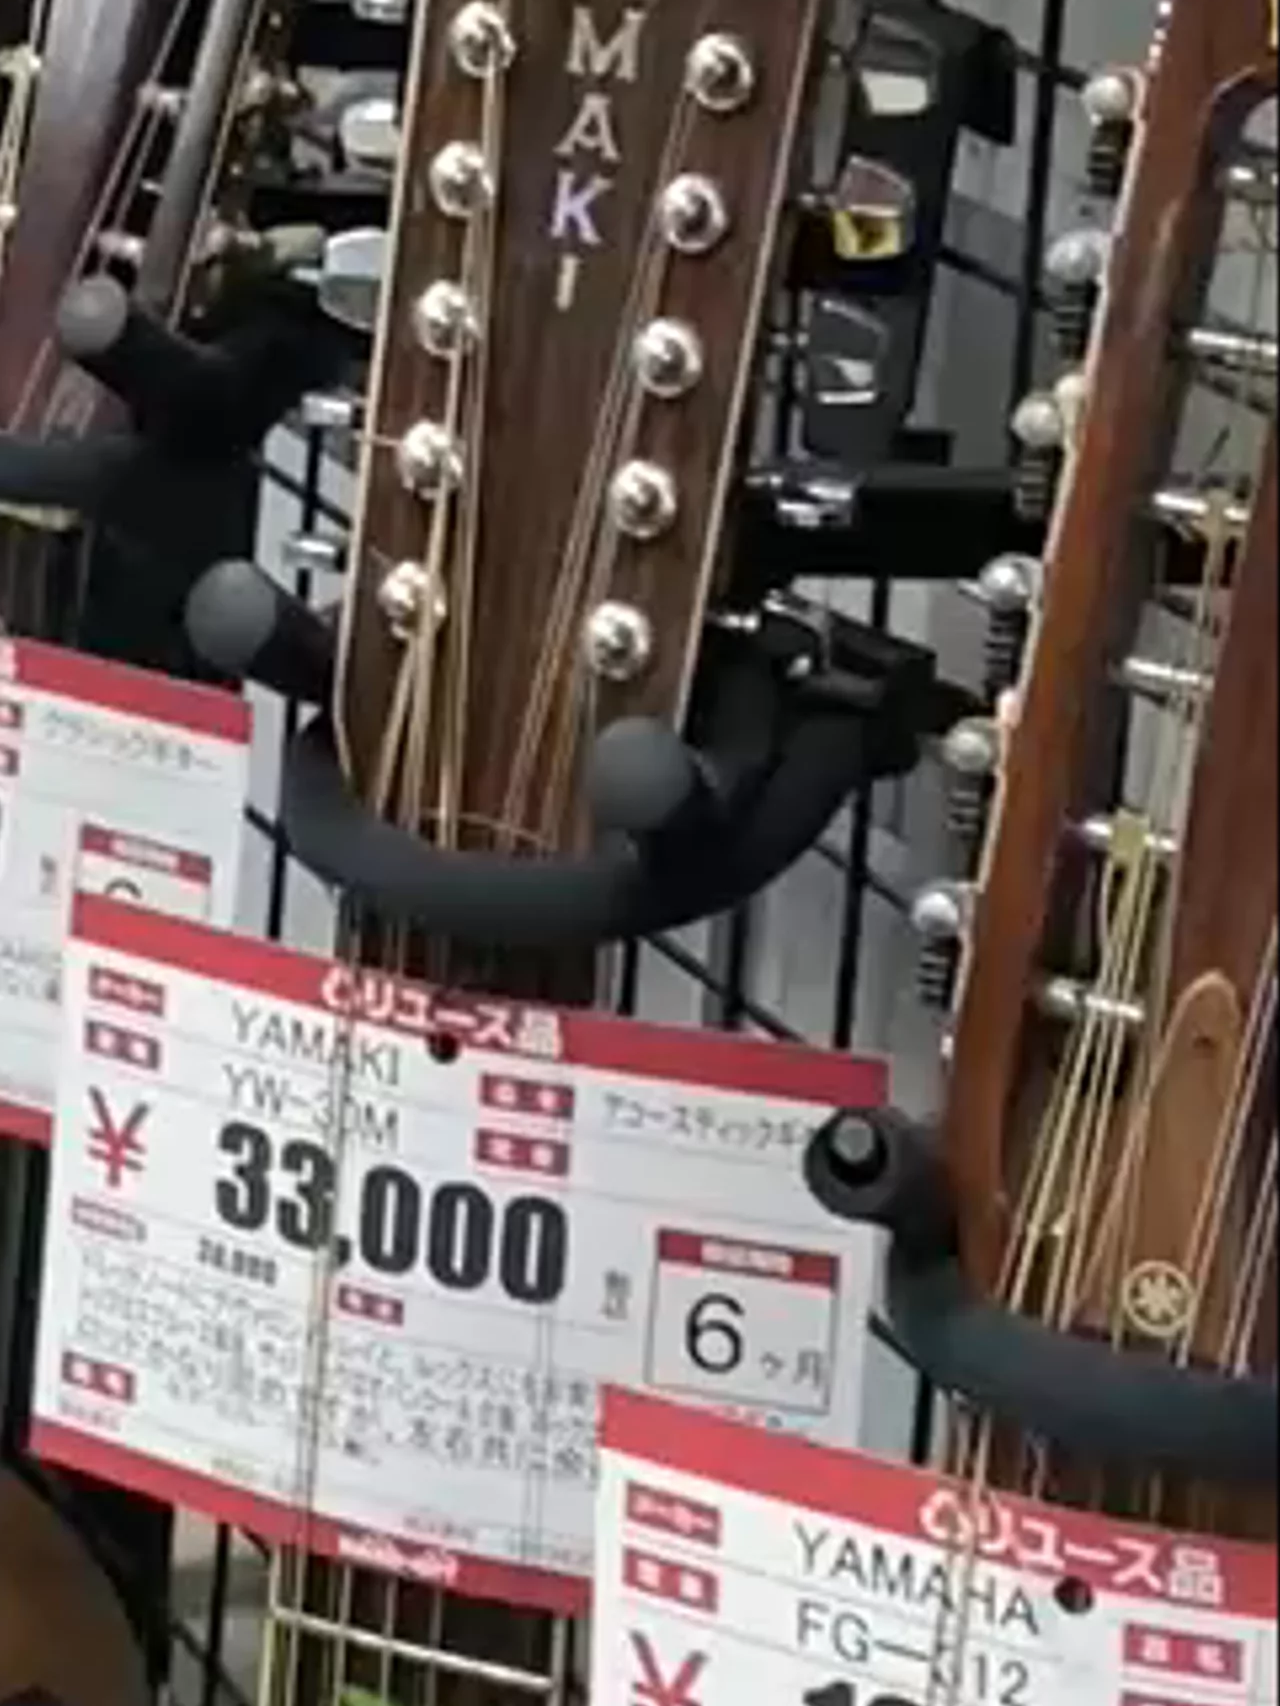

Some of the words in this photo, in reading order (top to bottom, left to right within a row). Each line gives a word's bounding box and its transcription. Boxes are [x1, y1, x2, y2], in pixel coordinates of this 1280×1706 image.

[231, 998, 401, 1087] YAMAKI
[86, 1086, 149, 1188] ¥
[214, 1119, 568, 1305] 33,000
[792, 1523, 1040, 1637] YAMAHA
[975, 1498, 1223, 1605] リユース品
